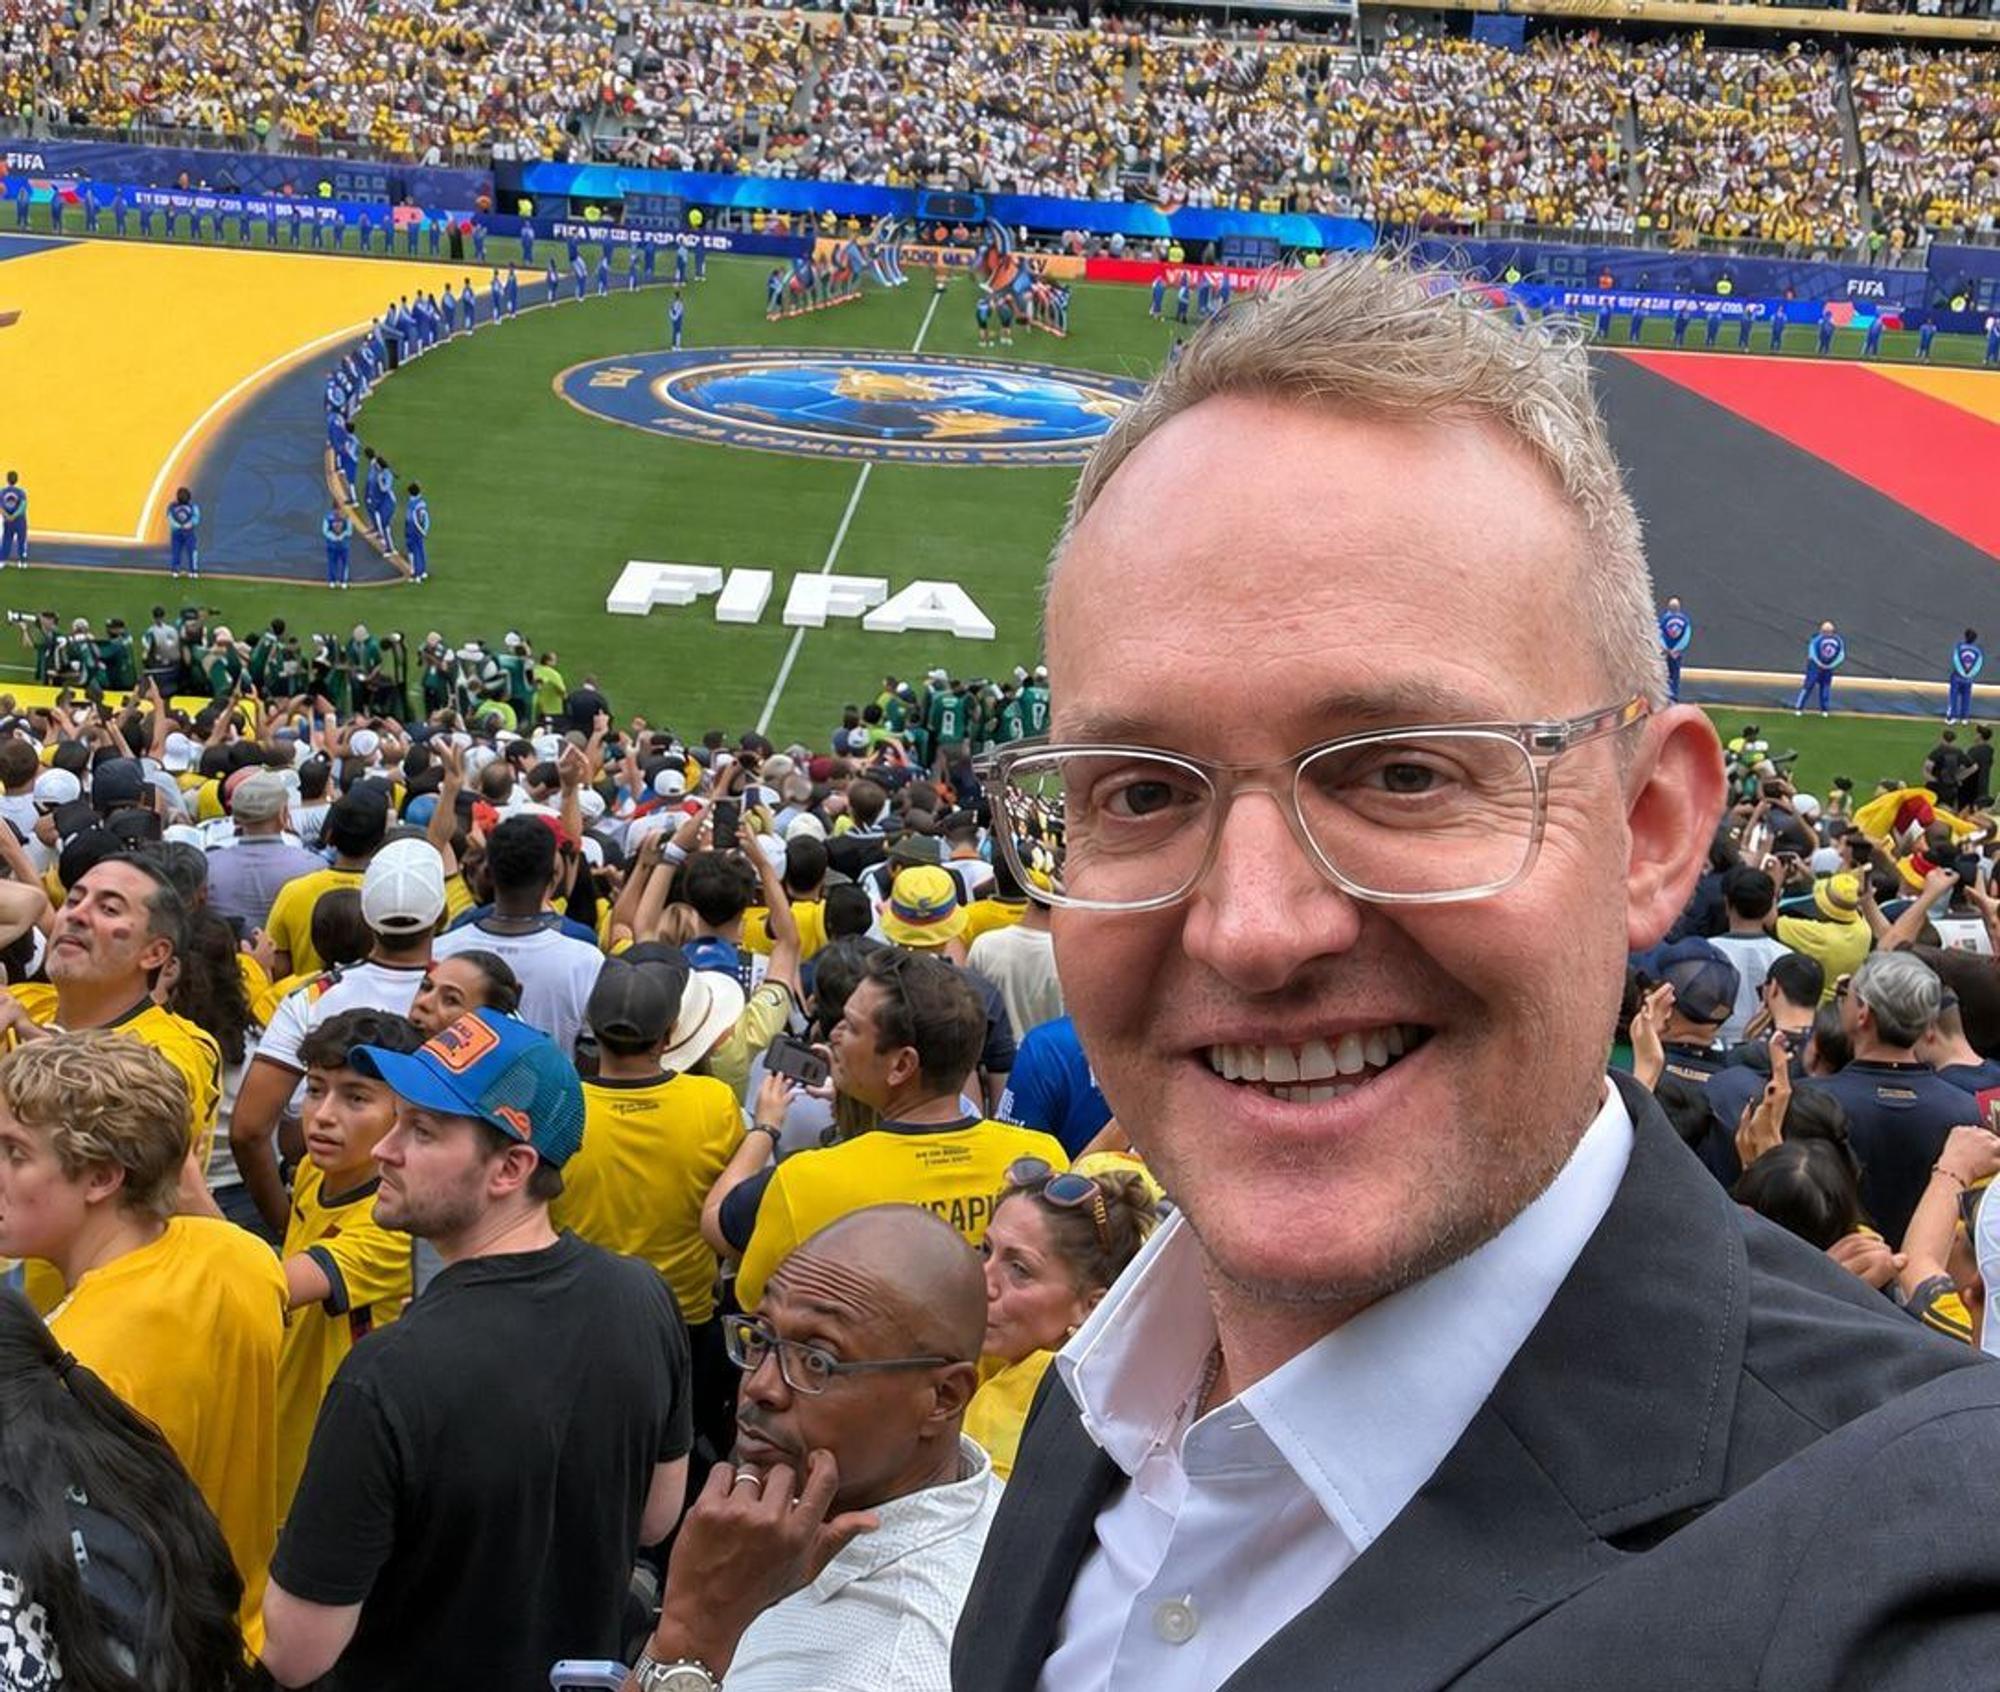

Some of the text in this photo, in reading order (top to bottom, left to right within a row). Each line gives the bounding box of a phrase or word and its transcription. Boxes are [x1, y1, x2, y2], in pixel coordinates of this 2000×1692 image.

[7, 153, 45, 171] FIFA
[1847, 279, 1885, 297] FIFA
[606, 560, 996, 640] FIFA
